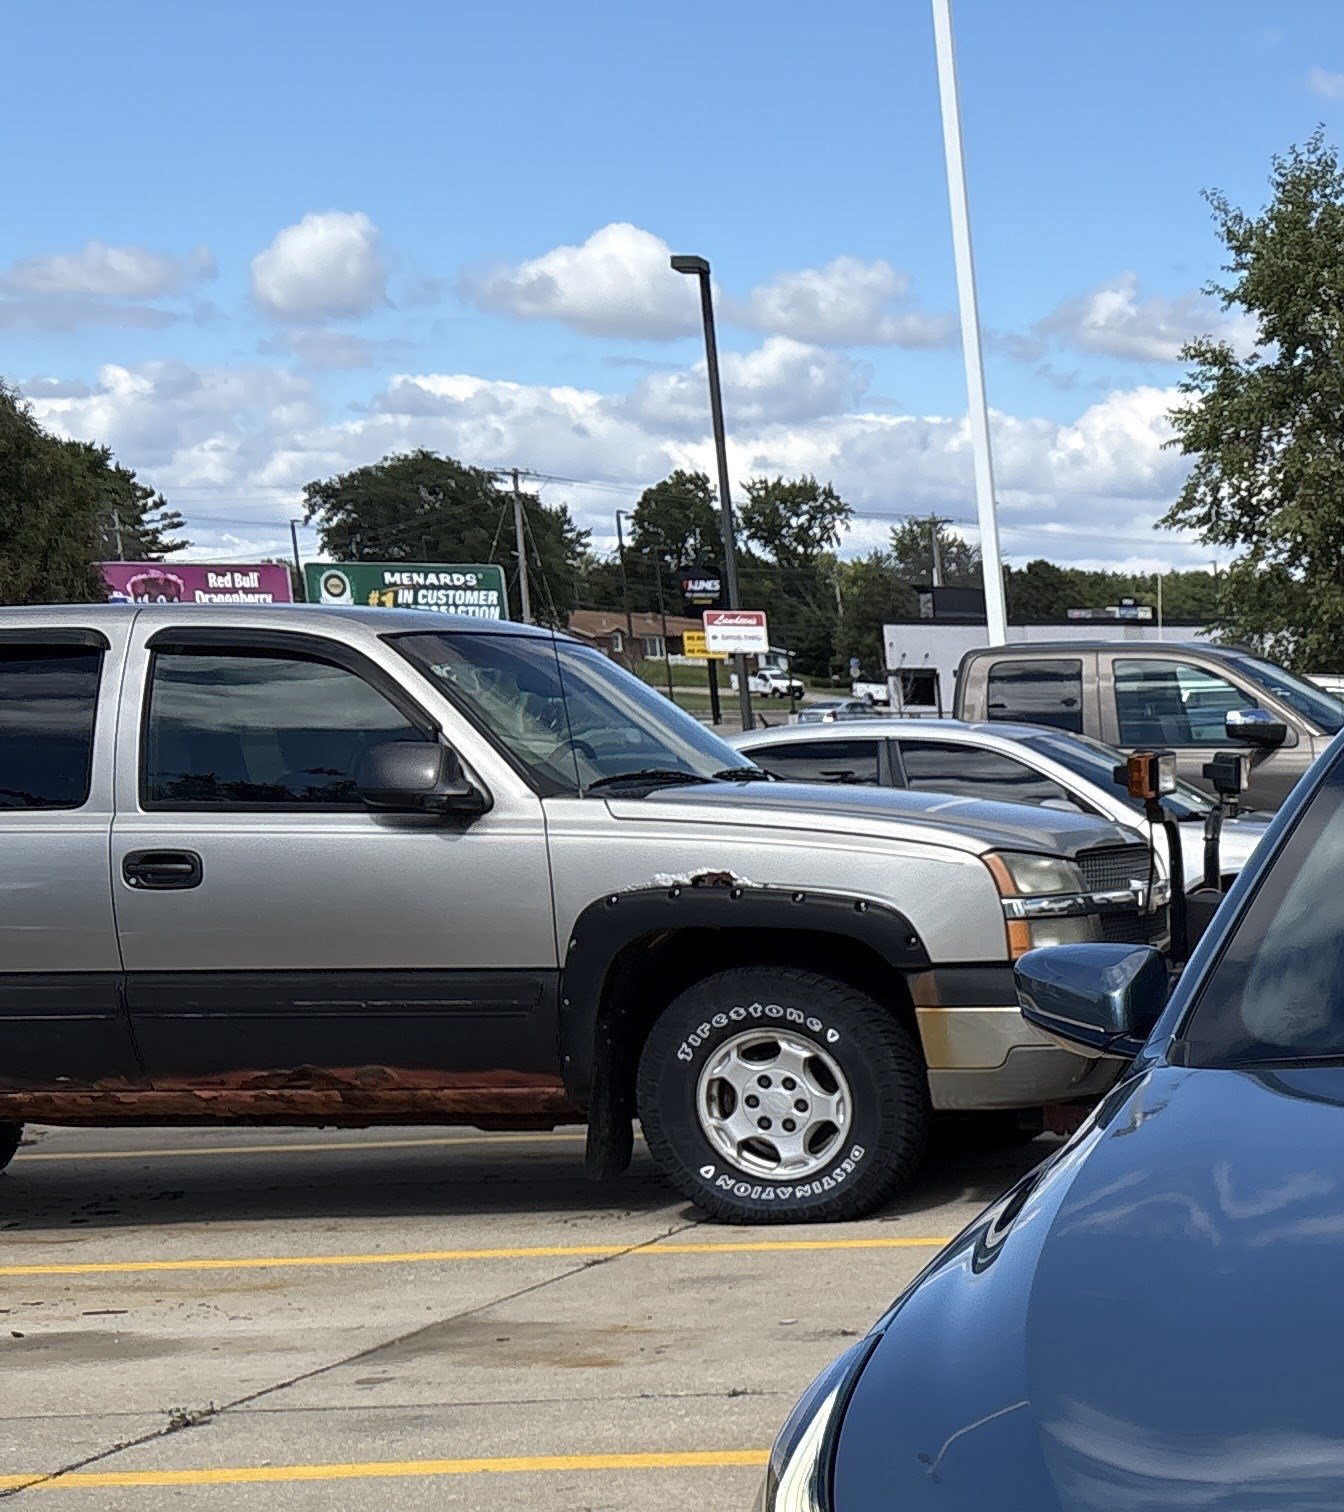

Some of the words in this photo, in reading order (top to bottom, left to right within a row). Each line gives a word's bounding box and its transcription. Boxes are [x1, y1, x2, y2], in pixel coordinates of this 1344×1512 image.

[207, 572, 232, 588] Red
[234, 572, 259, 588] Bull
[383, 571, 478, 586] MENARDS
[398, 589, 414, 604] IN
[417, 590, 498, 605] CUSTOMER
[677, 1003, 822, 1061] Firestone
[716, 1144, 865, 1200] DESTINATION
